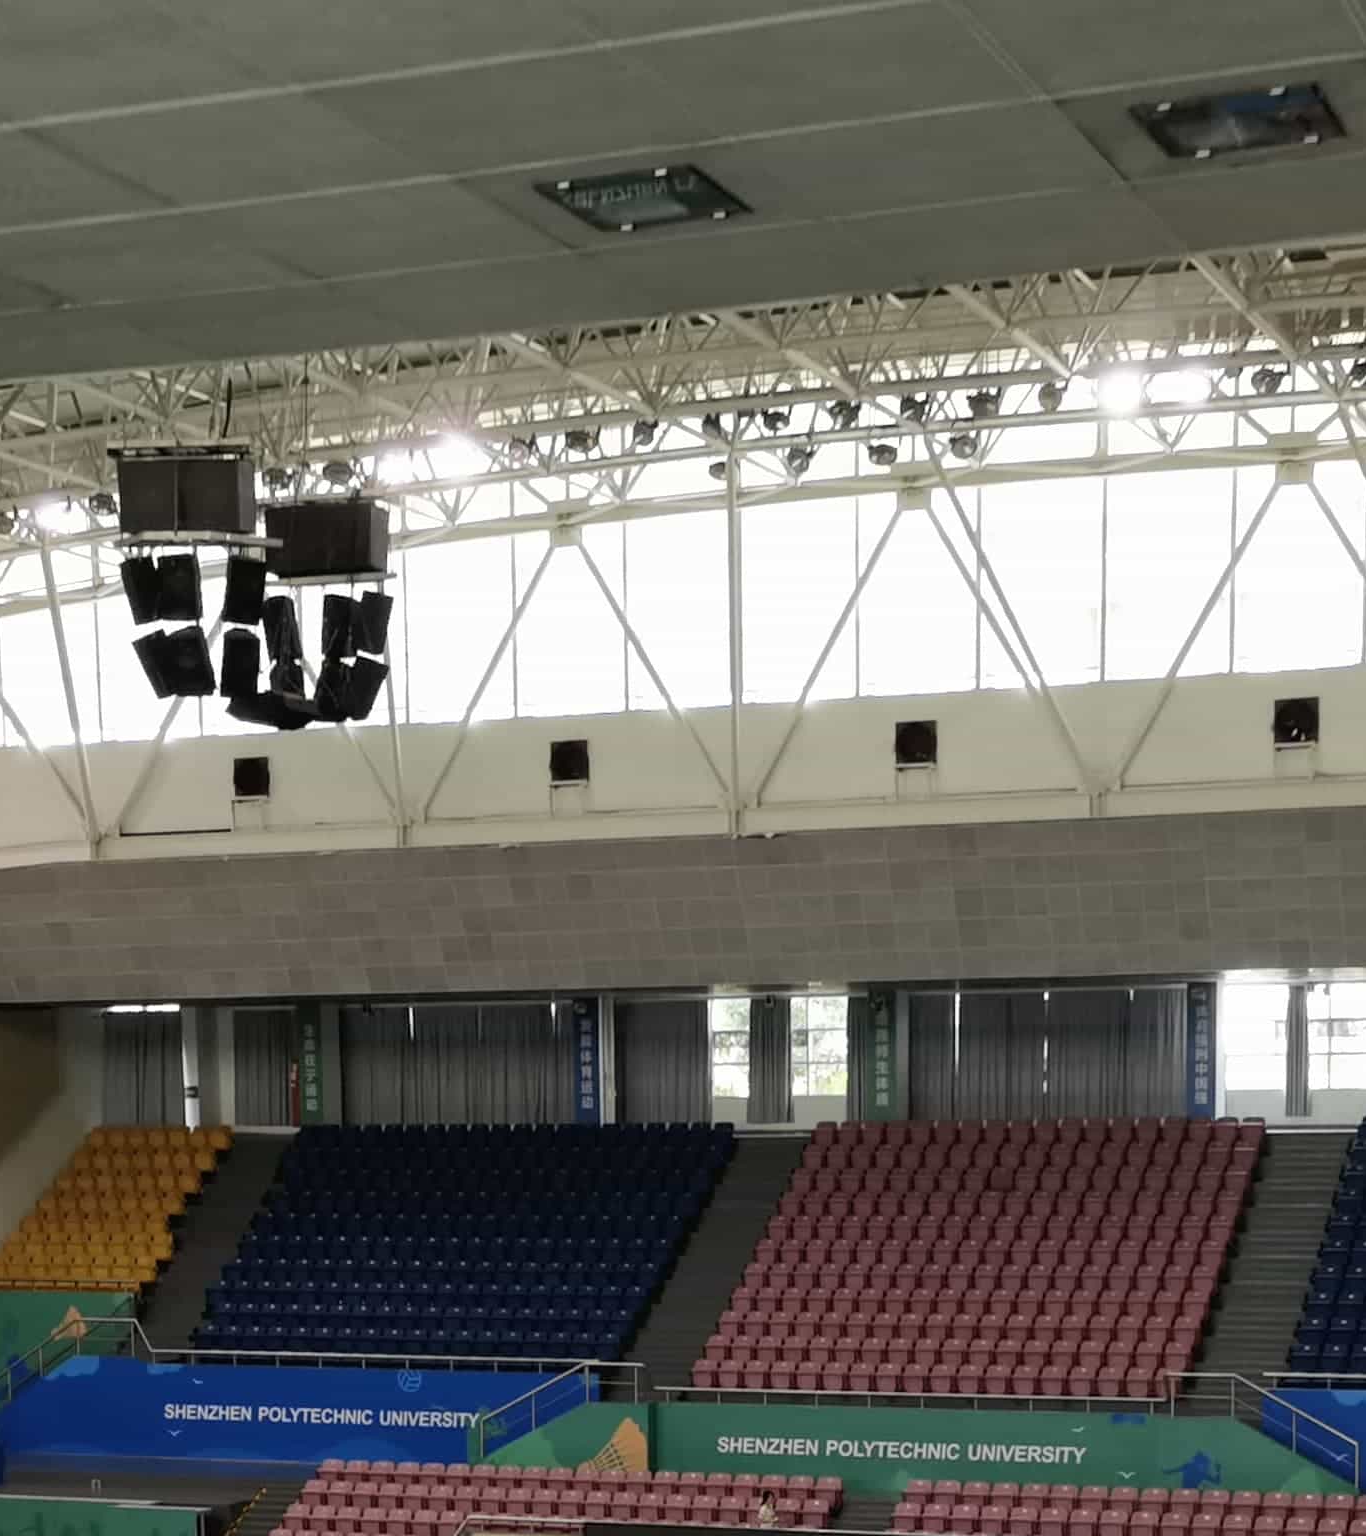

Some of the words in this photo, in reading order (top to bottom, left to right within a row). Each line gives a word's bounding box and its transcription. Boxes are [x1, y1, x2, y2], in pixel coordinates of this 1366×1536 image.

[164, 1404, 252, 1421] SHENZHEN
[258, 1407, 373, 1425] POLYTECHNIC
[379, 1410, 479, 1428] UNIVERSITY
[716, 1436, 819, 1457] SHENZHEN
[825, 1439, 960, 1461] POLYTECHNIC
[967, 1445, 1087, 1464] UNIVERSITY
